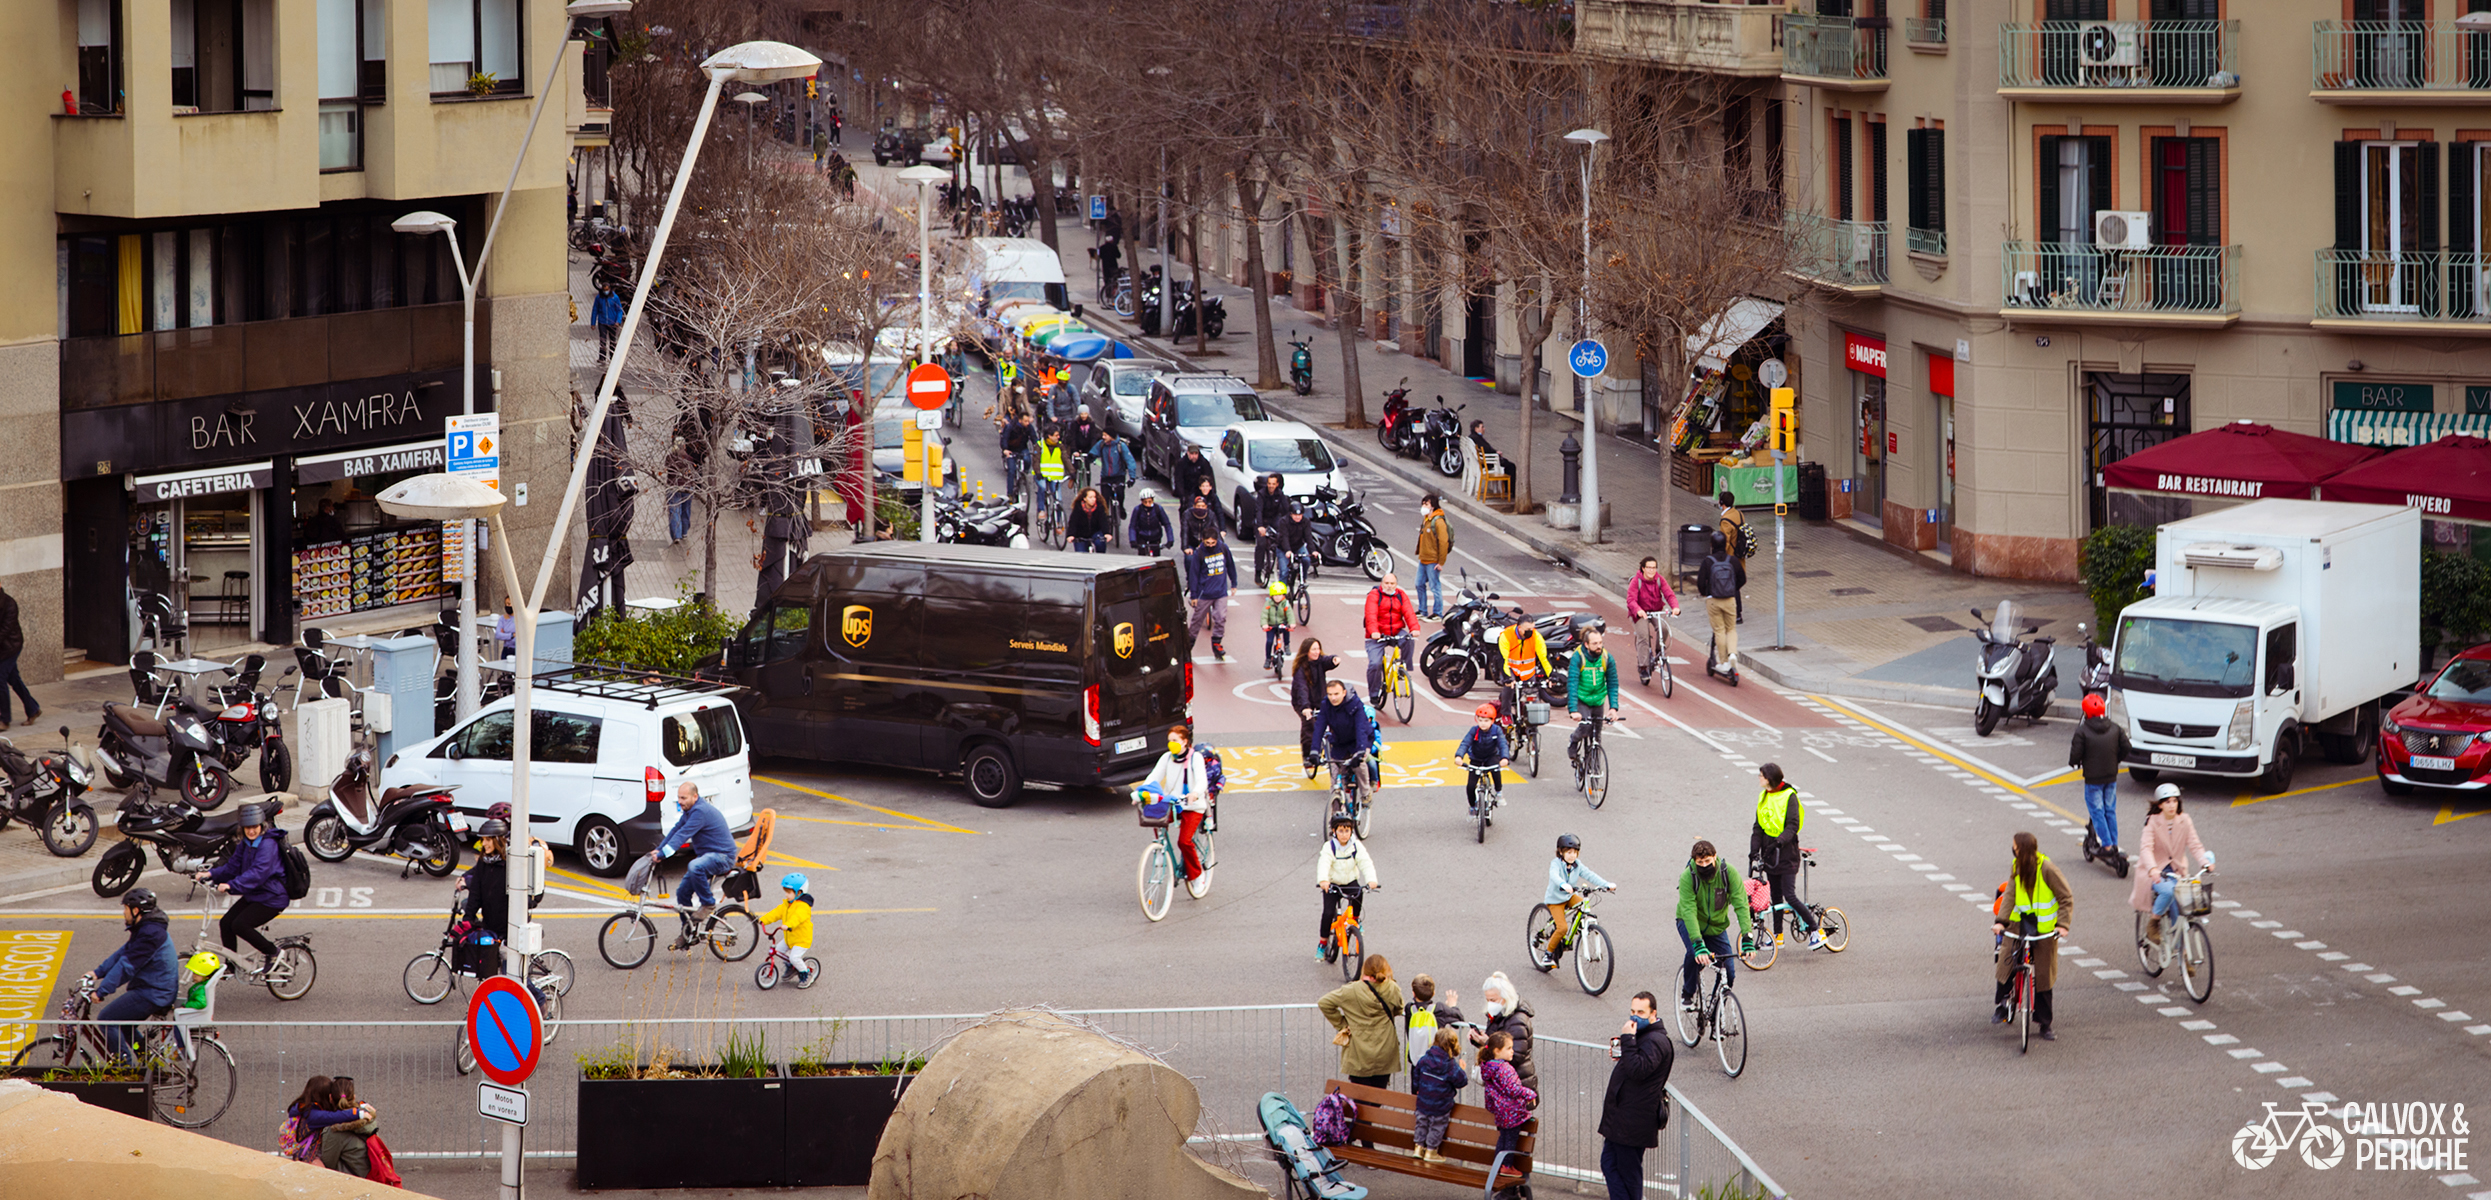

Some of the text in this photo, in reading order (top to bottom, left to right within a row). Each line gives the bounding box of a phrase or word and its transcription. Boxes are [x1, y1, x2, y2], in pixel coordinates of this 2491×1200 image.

[2361, 387, 2404, 406] BAR
[191, 391, 422, 449] BAR XAMFRA
[453, 435, 468, 457] P
[2357, 426, 2409, 445] BAR
[344, 457, 375, 477] BAR
[380, 448, 443, 472] XAMFRA
[156, 472, 255, 499] CAFETERIA
[2157, 474, 2263, 498] BAR RESTAURANT
[2406, 494, 2451, 514] VIVERO
[845, 618, 869, 641] ups
[1009, 639, 1068, 653] Serveis Mundials
[1116, 632, 1132, 654] ups
[494, 1093, 514, 1105] Motos
[497, 1105, 518, 1116] vorera
